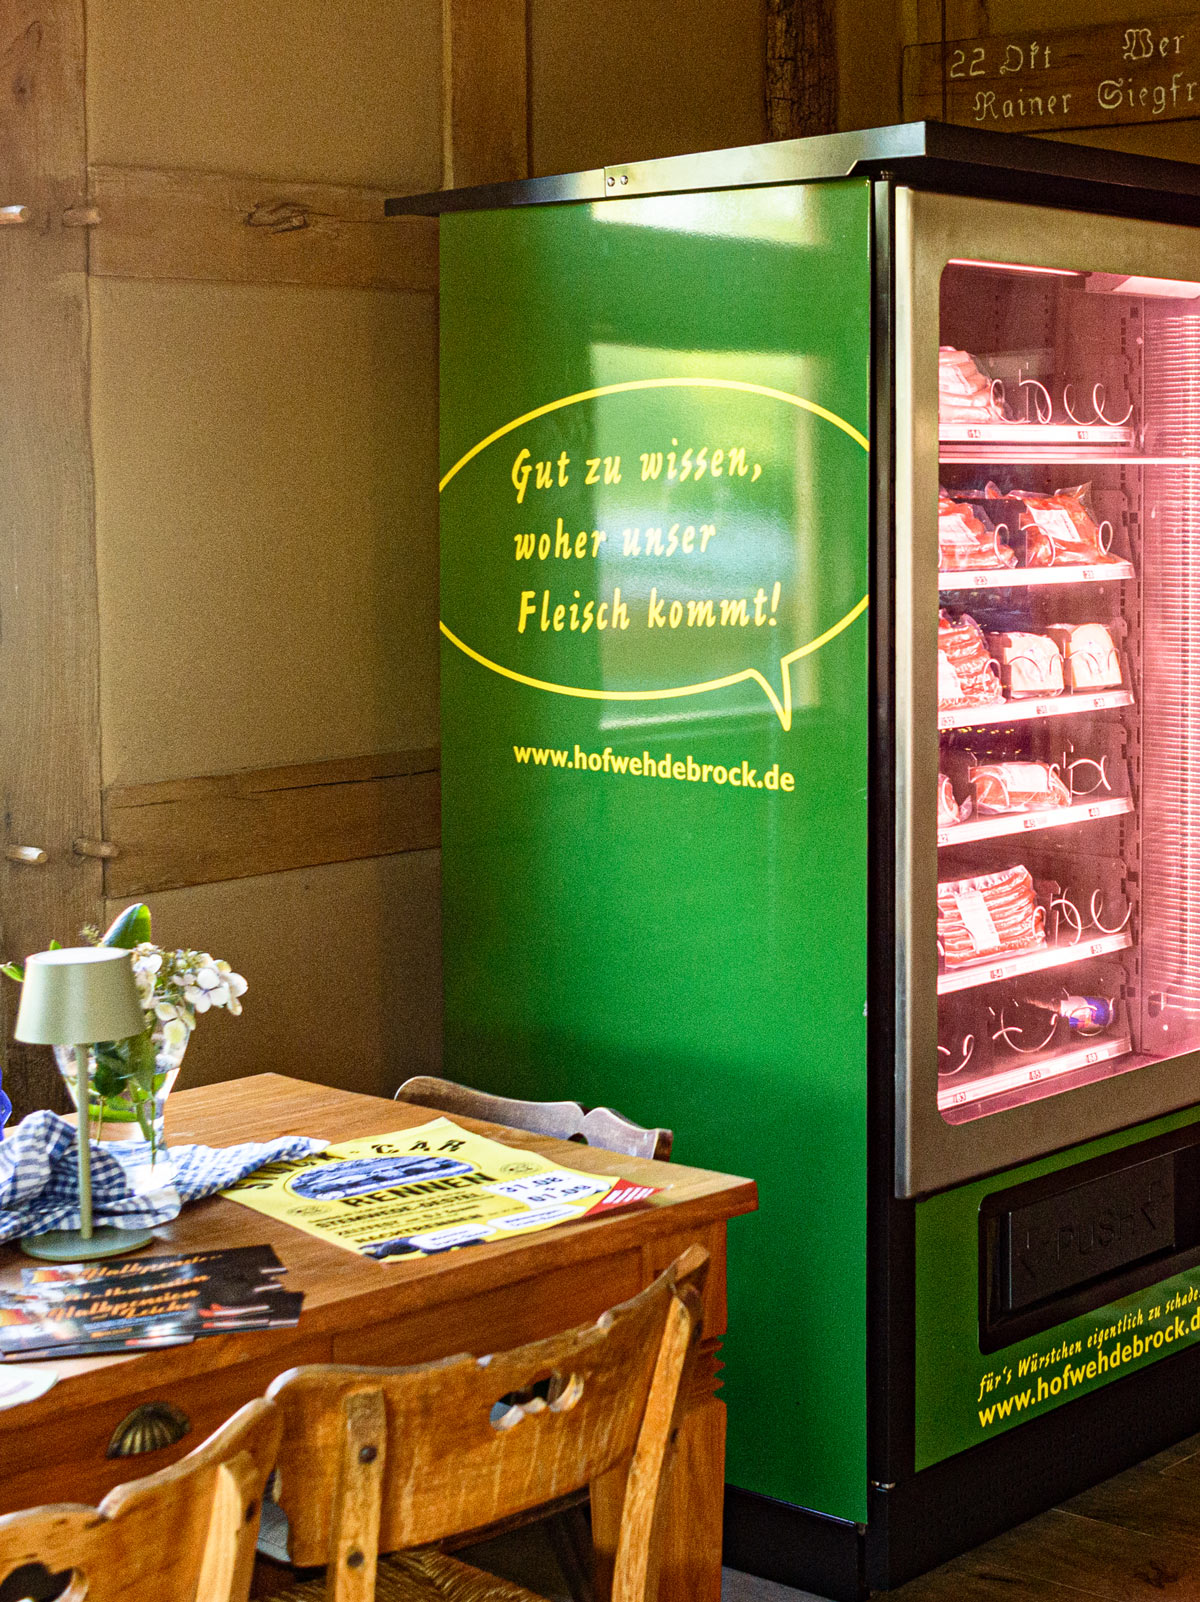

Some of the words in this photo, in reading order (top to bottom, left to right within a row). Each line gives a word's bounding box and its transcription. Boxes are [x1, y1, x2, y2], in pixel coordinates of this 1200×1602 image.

[950, 48, 986, 78] 22
[1122, 28, 1185, 60] Wer
[972, 88, 1072, 121] Rainer
[511, 447, 570, 504] Gut
[584, 455, 622, 485] zu
[640, 437, 763, 482] wissen,
[514, 517, 606, 561] woher
[622, 522, 717, 558] unser
[517, 587, 631, 634] Fleisch
[647, 581, 781, 629] kommt!
[513, 744, 795, 792] www.hofwehdebrock.de
[338, 1172, 498, 1207] RENNEN
[1017, 1340, 1082, 1379] Würstchen
[1086, 1308, 1144, 1350] eigentlich
[1148, 1303, 1161, 1321] zu
